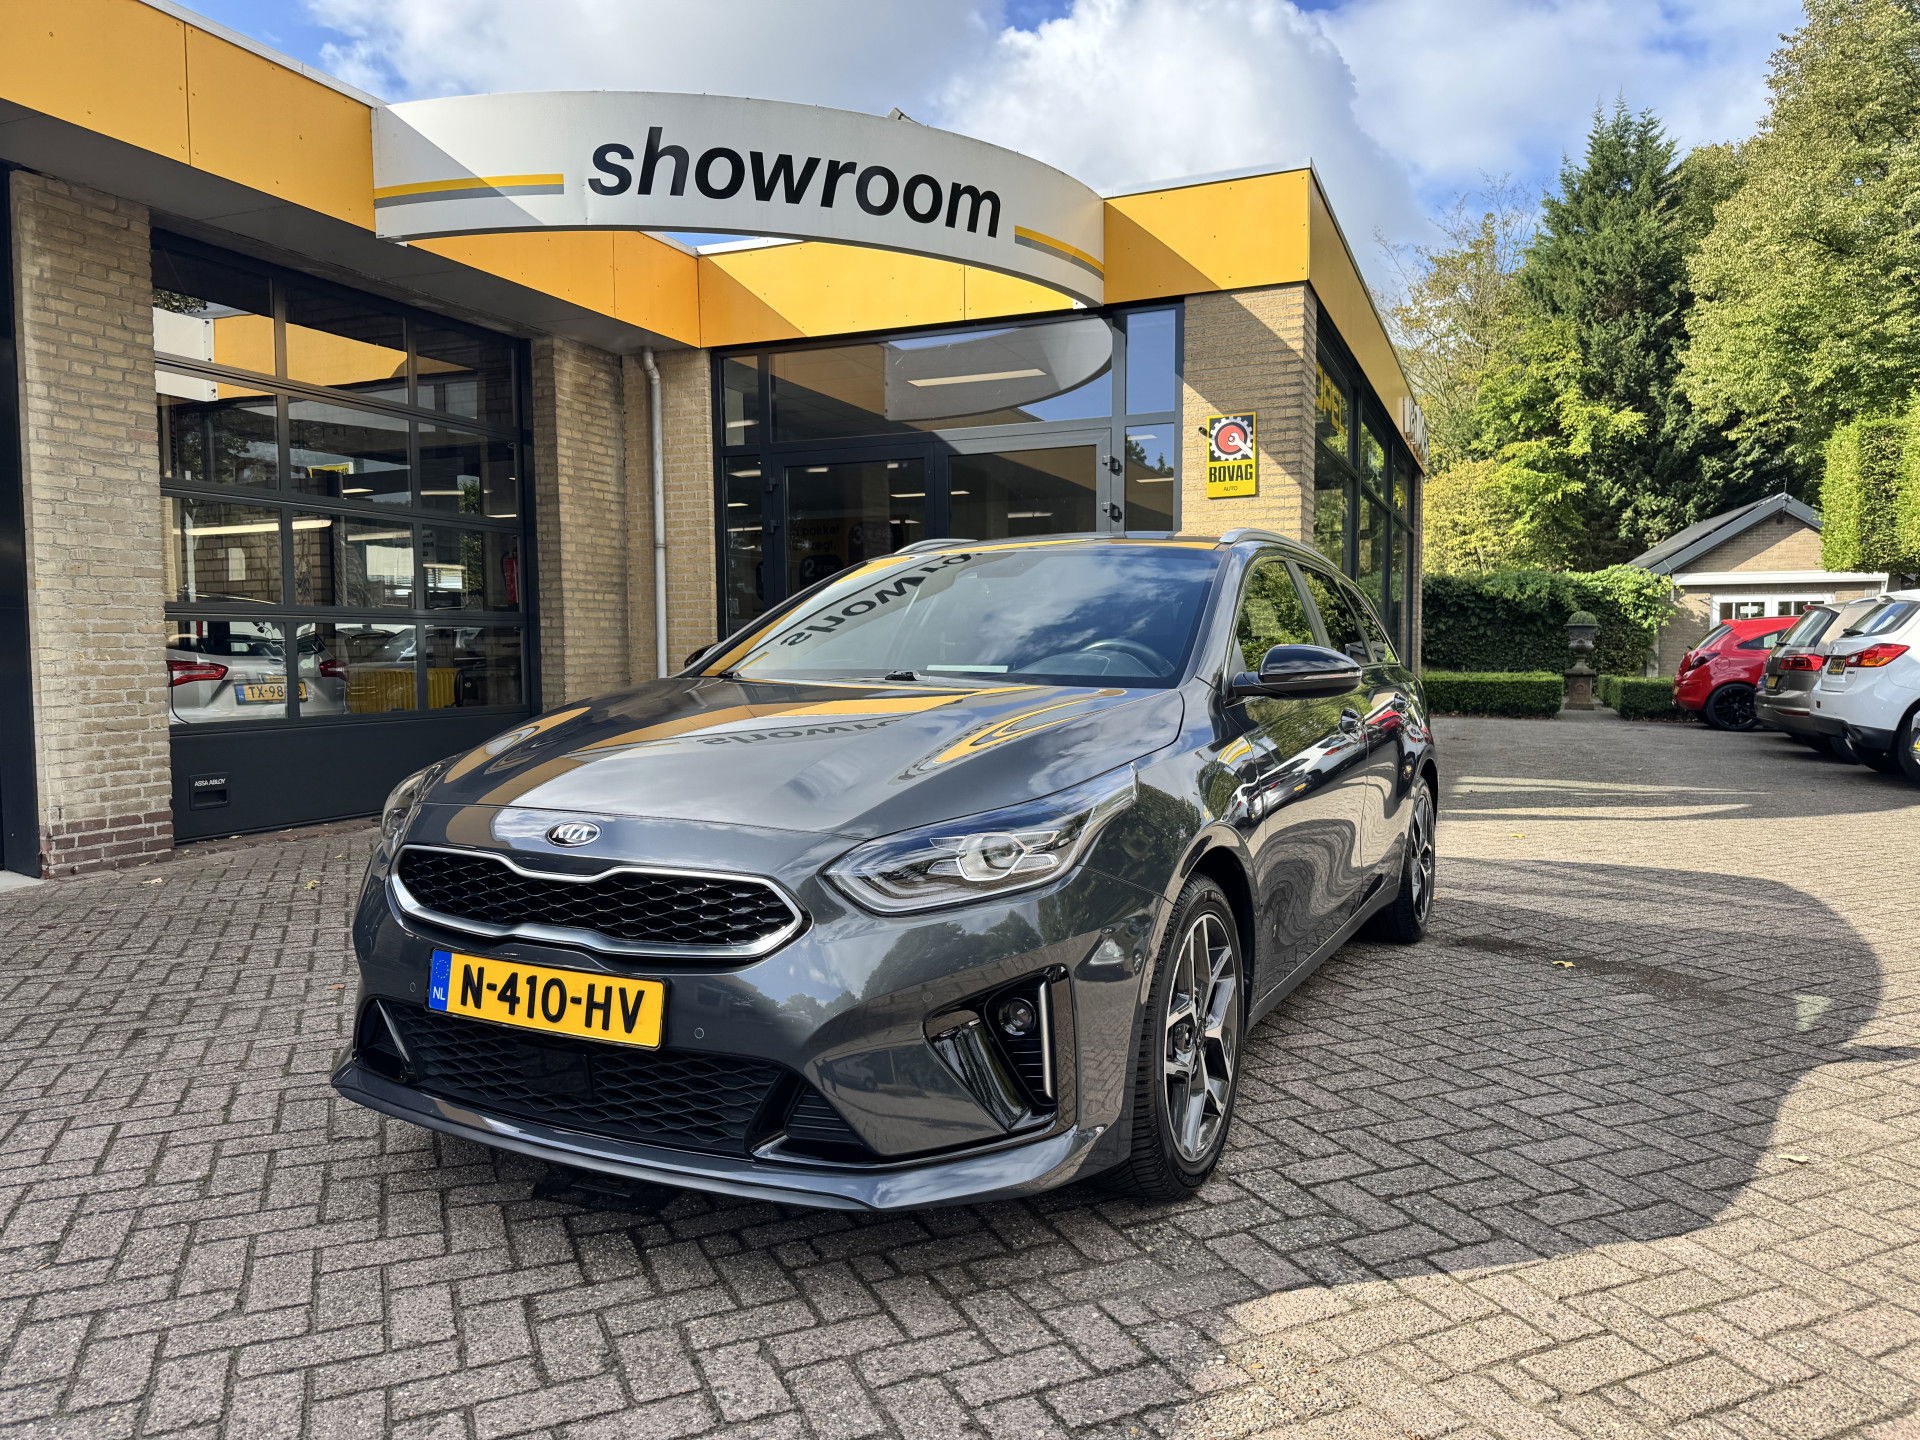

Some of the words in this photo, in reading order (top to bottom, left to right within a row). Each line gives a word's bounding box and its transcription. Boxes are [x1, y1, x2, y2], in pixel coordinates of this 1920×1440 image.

[588, 126, 1001, 238] showroom
[1208, 464, 1253, 483] BOVAG
[209, 778, 226, 786] ABLOY
[551, 824, 590, 841] KIA
[432, 986, 446, 1001] NL
[460, 963, 646, 1034] N-410-HV
